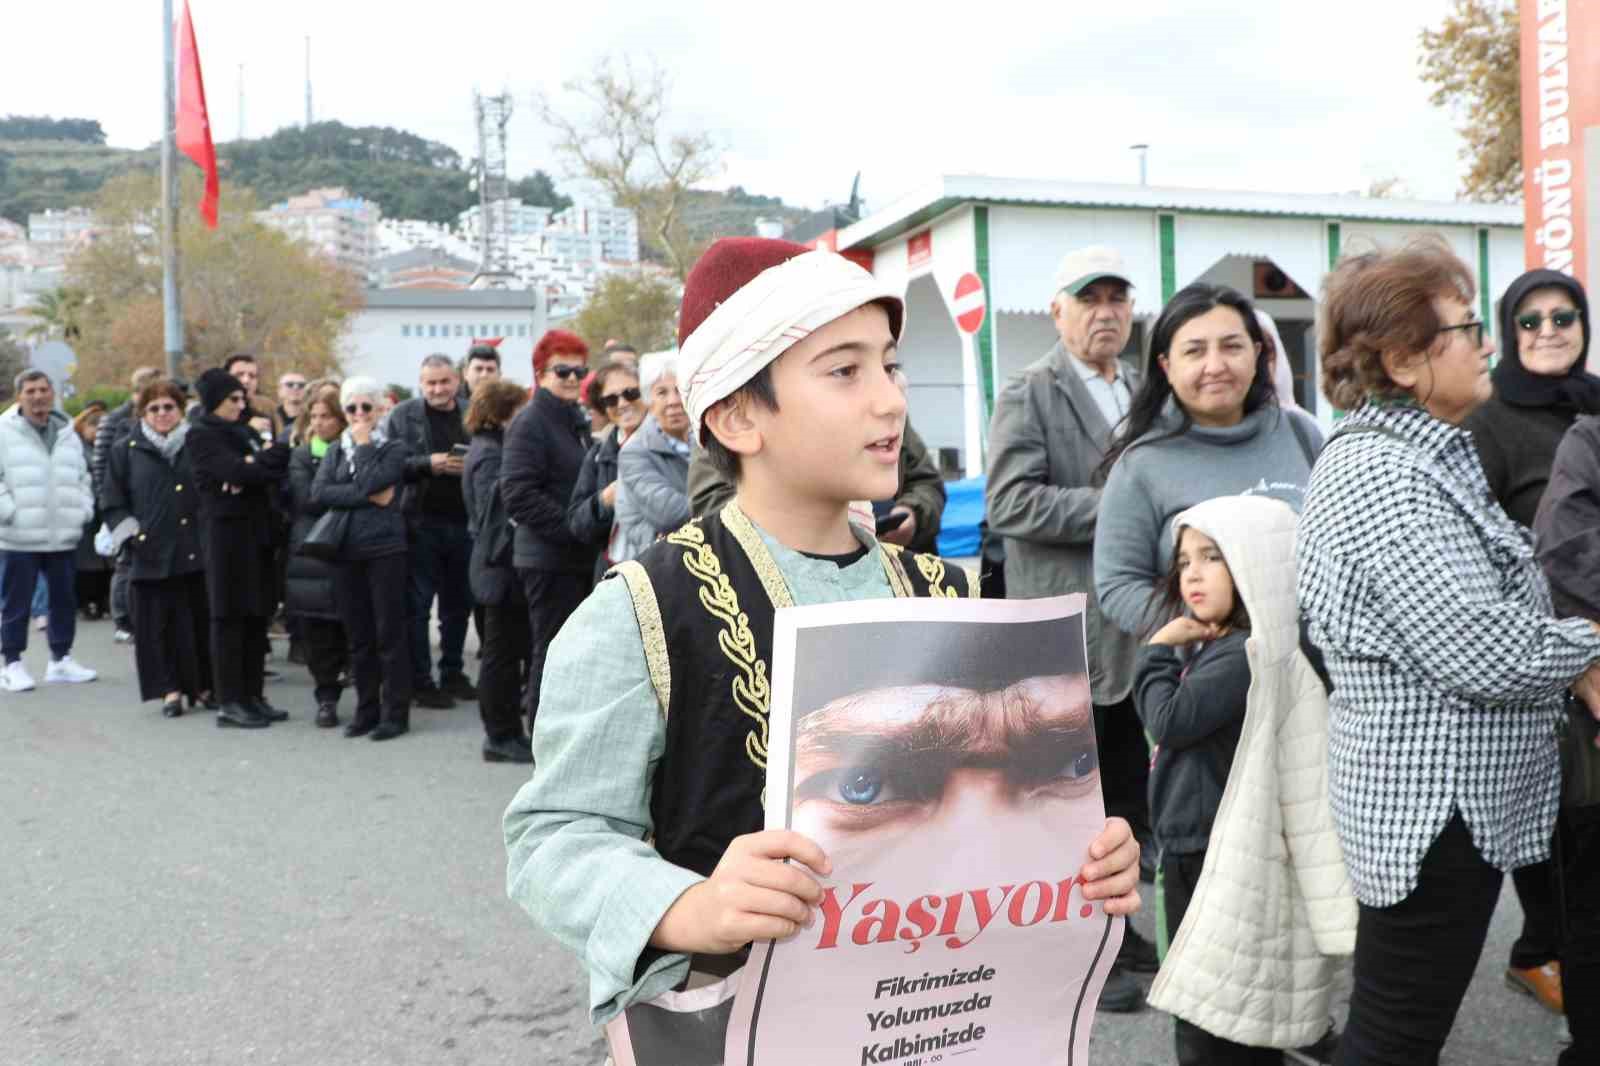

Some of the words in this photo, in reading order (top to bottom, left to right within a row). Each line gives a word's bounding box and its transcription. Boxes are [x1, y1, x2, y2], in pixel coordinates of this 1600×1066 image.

[815, 873, 1093, 954] Yaşıyor.
[874, 964, 996, 999] Fikrimizde
[866, 992, 992, 1032] Yolumuzda
[861, 1022, 986, 1066] Kalbimizde
